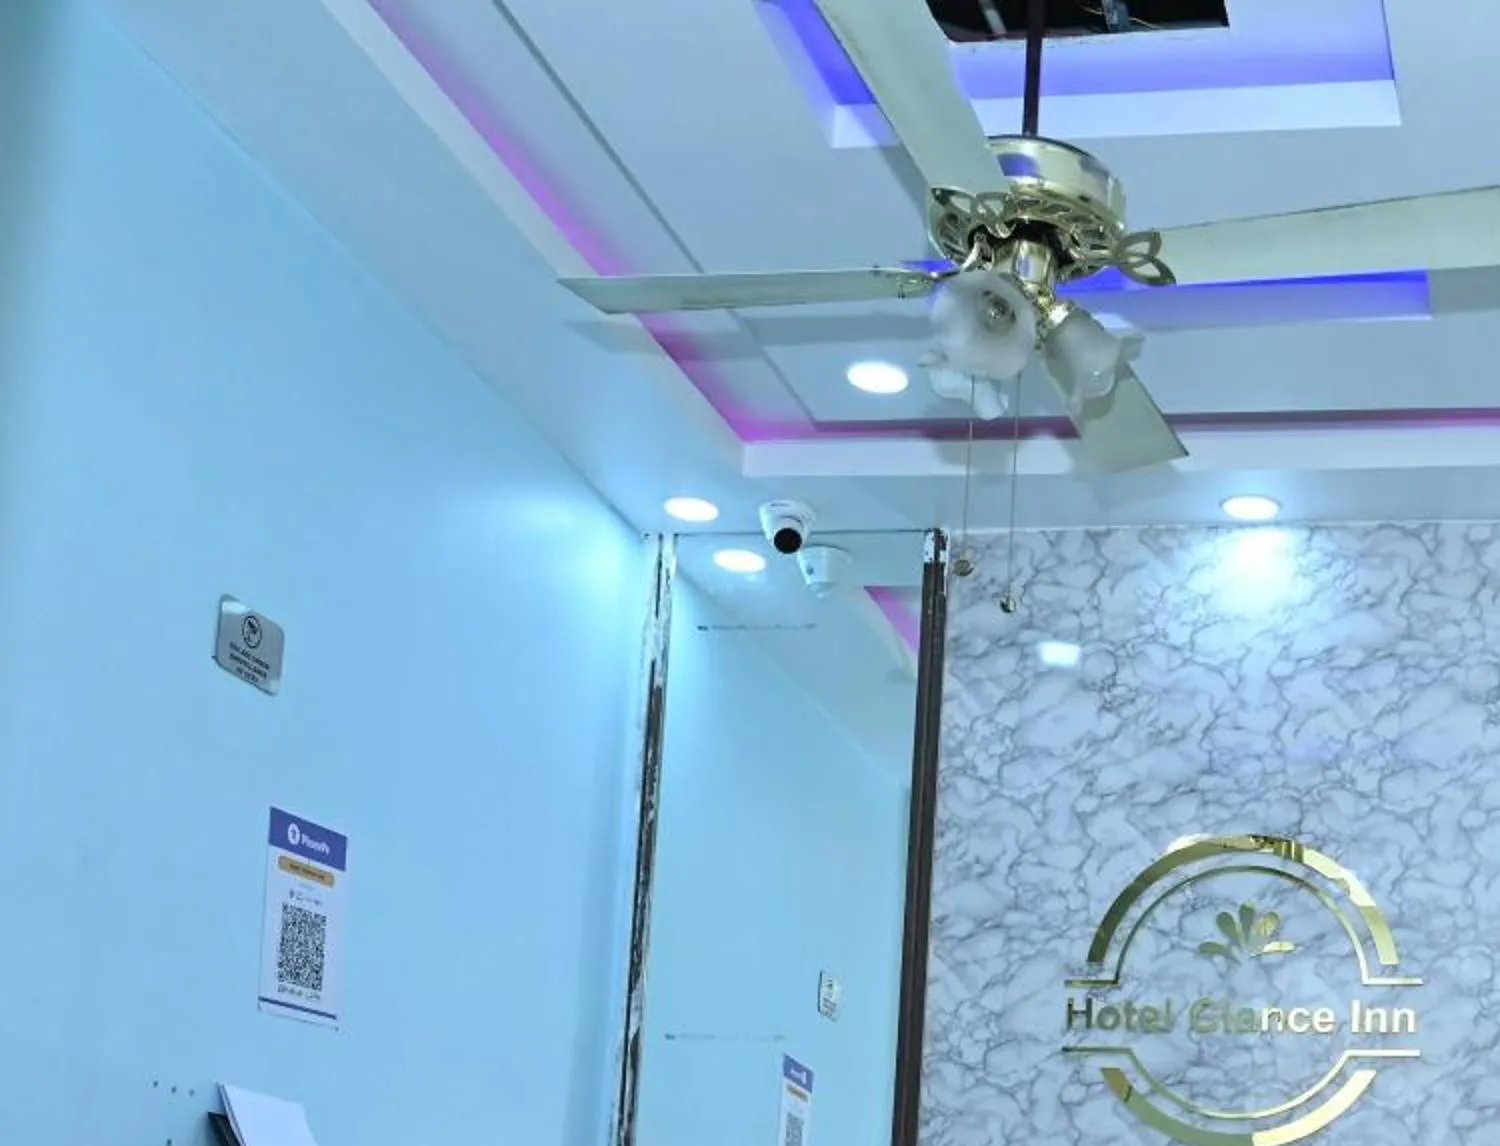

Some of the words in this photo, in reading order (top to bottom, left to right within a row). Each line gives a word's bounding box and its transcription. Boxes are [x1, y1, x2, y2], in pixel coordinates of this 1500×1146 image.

[1066, 997, 1172, 1034] Hotel
[1189, 997, 1336, 1035] Glance
[1350, 998, 1417, 1034] Inn
